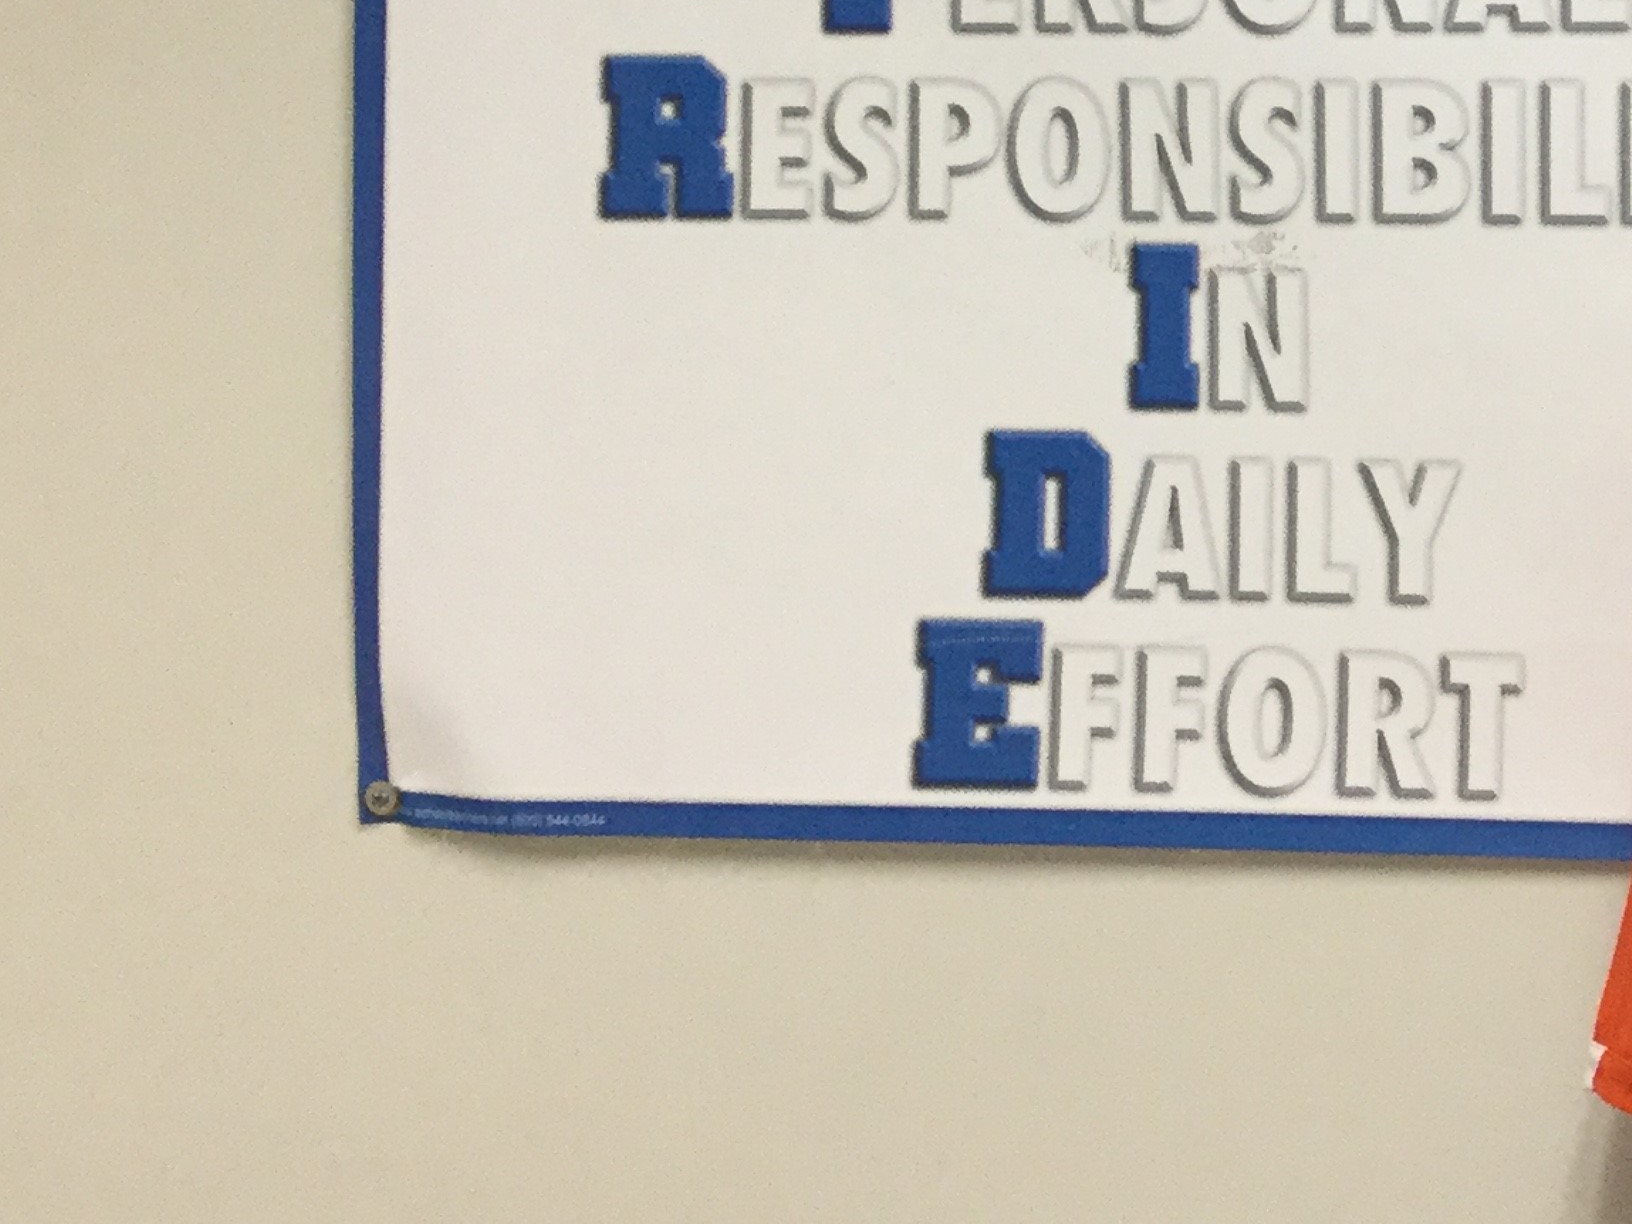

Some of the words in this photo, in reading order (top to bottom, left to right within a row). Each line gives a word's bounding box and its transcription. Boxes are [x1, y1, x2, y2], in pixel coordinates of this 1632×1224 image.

[1128, 241, 1309, 413] IN
[981, 428, 1463, 606] DAILY
[911, 617, 1527, 801] EFFORT
